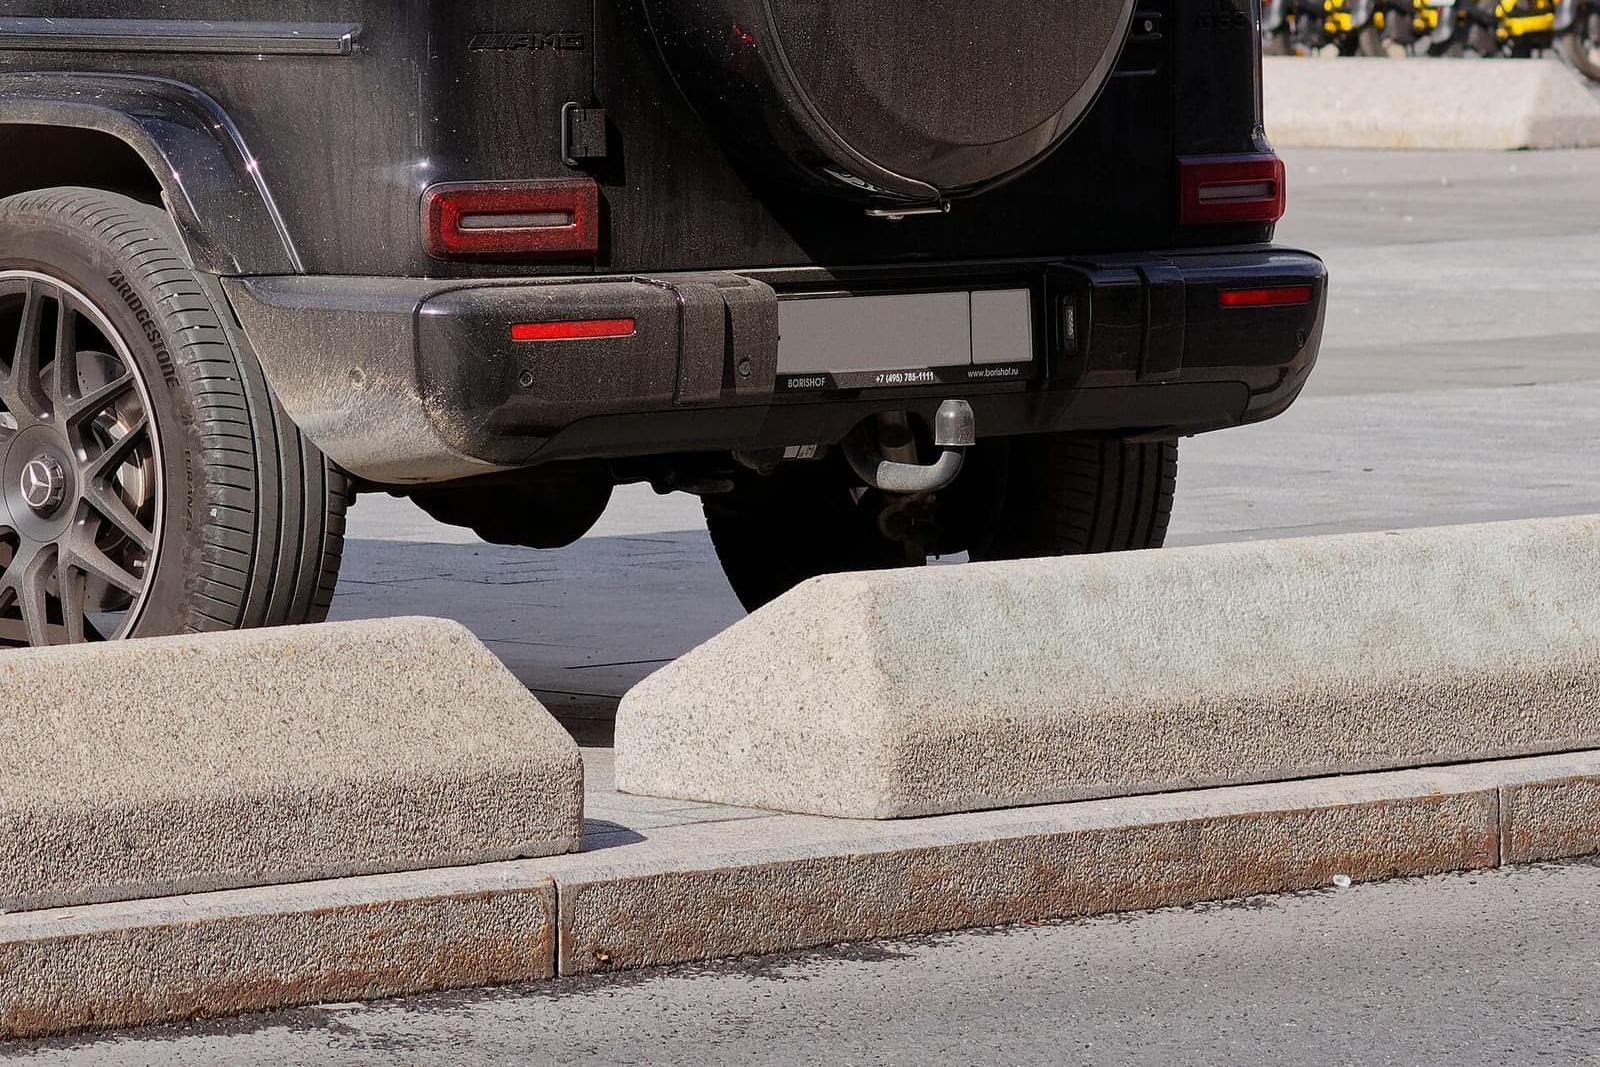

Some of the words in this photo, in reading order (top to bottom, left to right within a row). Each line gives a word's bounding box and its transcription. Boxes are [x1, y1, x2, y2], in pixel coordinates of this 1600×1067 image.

[105, 270, 181, 390] BRIDGESTONE
[787, 377, 826, 389] BORISHOF
[875, 375, 884, 383] +7
[885, 373, 903, 383] (495)
[904, 371, 934, 382] 785-1111
[967, 367, 1019, 378] www.borishof.ru
[184, 447, 194, 533] TURANZA
